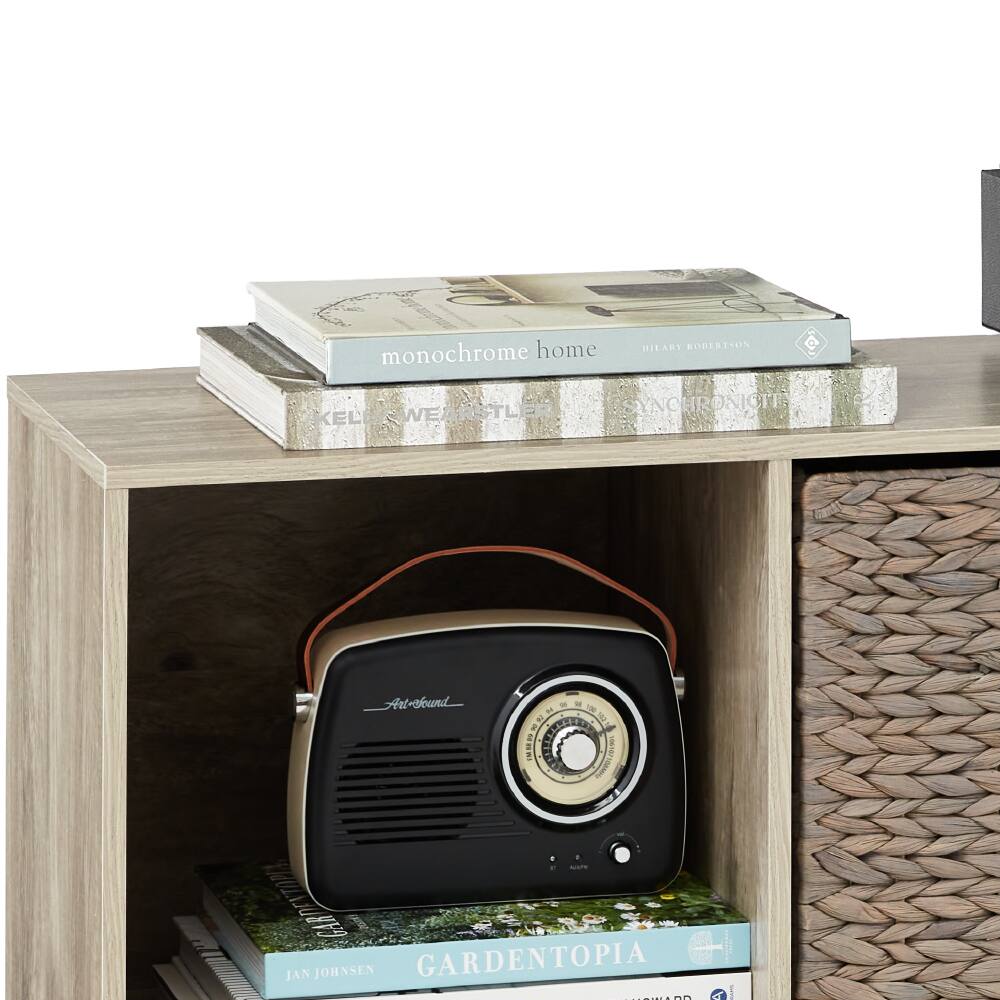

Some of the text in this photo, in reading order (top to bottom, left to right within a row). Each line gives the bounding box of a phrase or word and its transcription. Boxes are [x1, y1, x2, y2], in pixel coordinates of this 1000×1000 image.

[382, 338, 597, 366] monochrome home
[641, 340, 750, 354] HILARY ROBERTSON
[417, 940, 648, 978] GARDENTOPIA
[285, 964, 376, 982] JAN JOHNSEN
